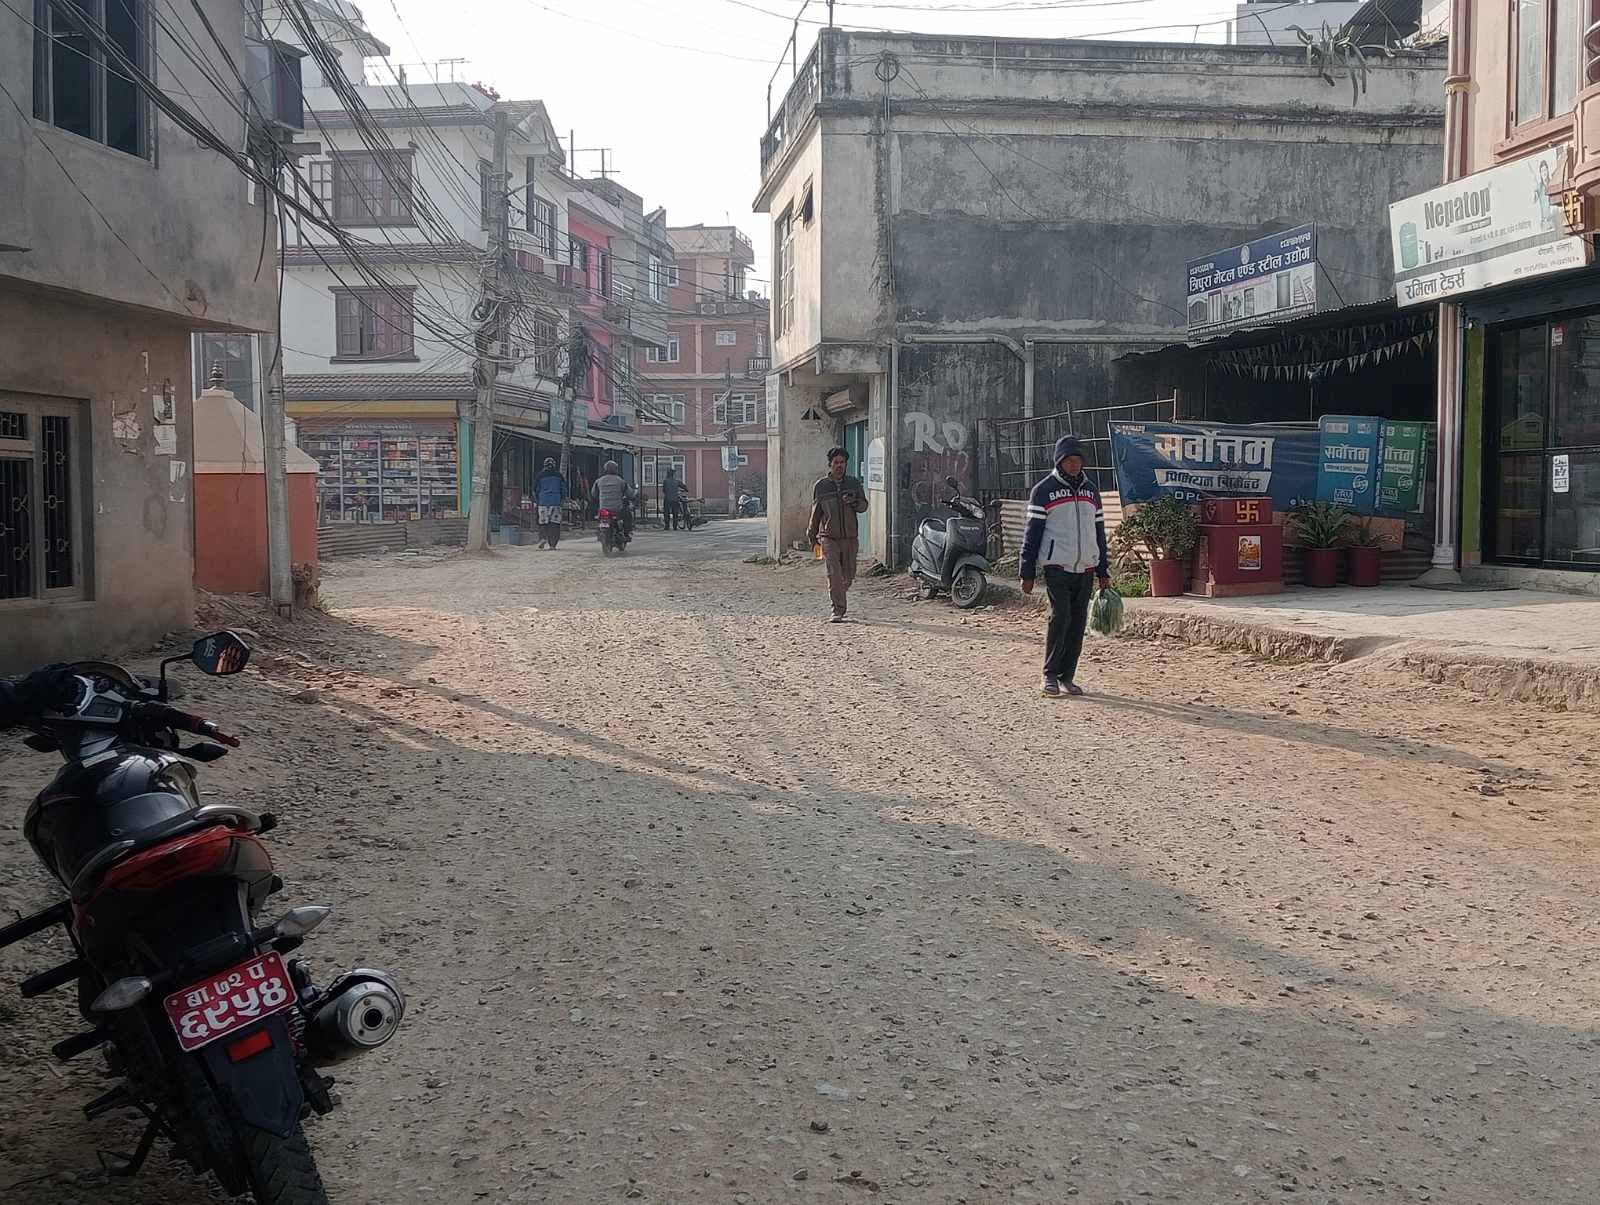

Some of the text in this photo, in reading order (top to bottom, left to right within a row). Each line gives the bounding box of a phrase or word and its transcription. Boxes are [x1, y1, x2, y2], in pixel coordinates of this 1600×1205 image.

[1424, 187, 1491, 230] Nepatop
[1213, 268, 1235, 284] मेटल
[1258, 254, 1283, 273] स्टील
[1404, 278, 1438, 299] रमिला
